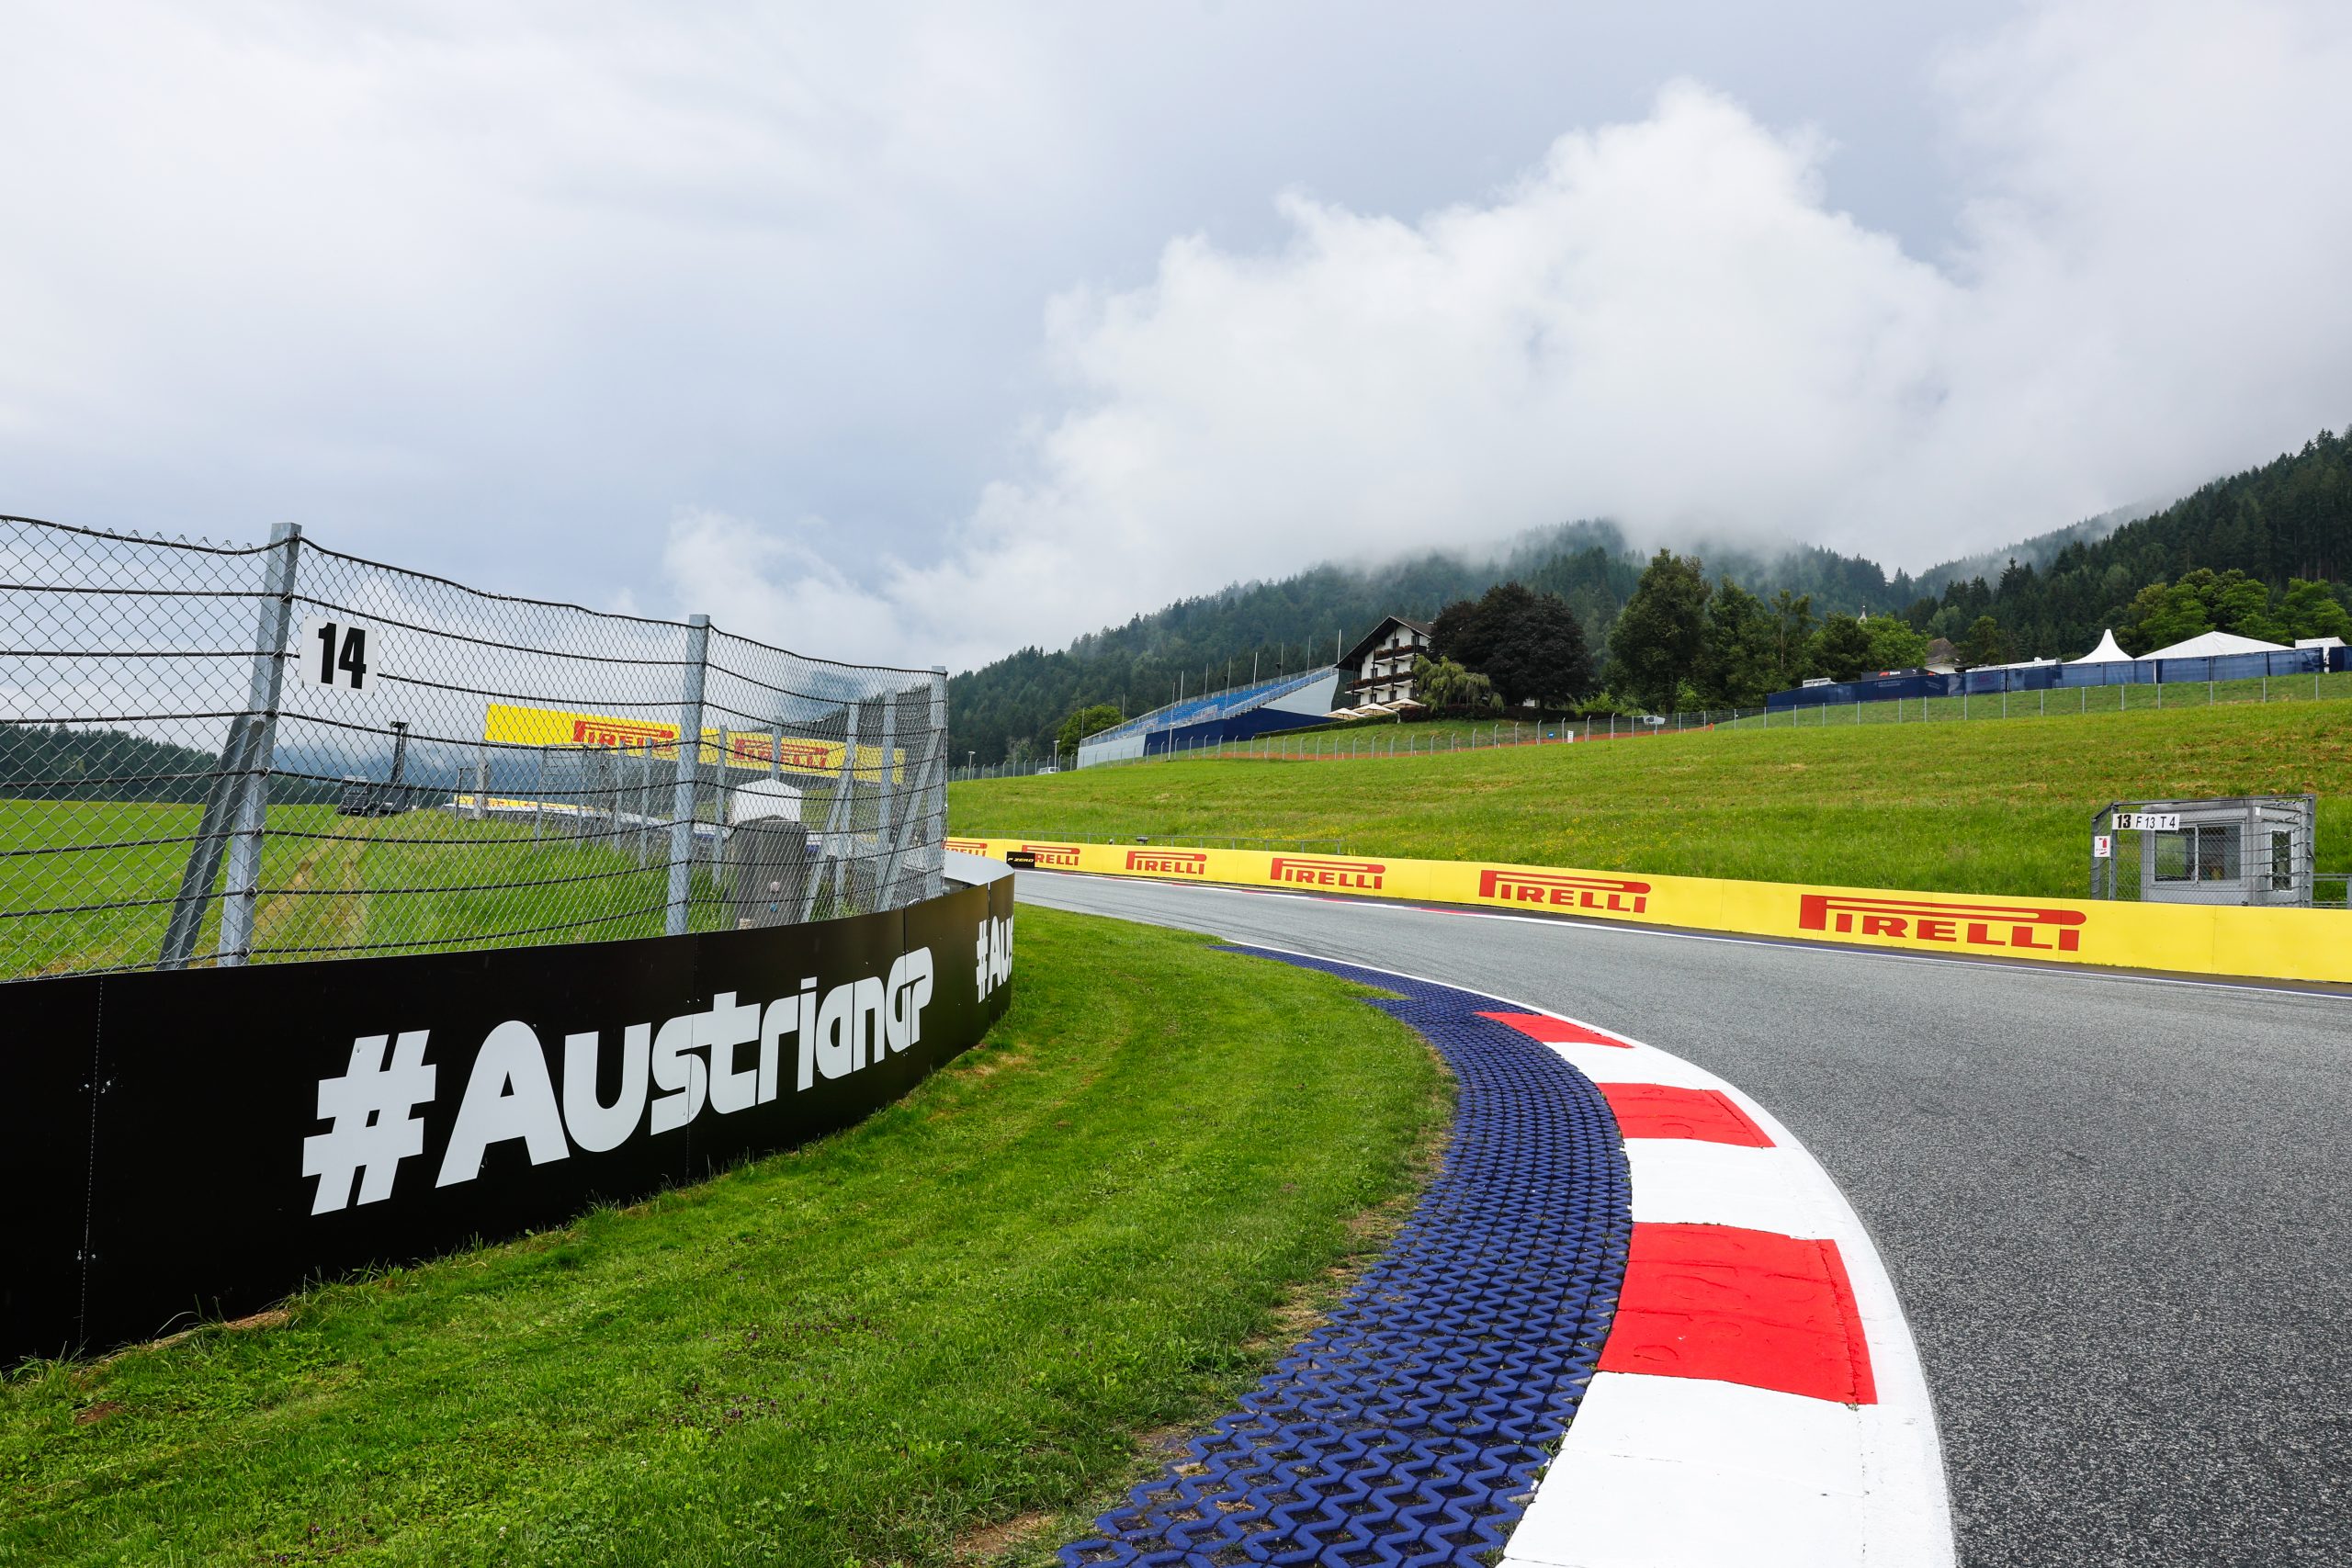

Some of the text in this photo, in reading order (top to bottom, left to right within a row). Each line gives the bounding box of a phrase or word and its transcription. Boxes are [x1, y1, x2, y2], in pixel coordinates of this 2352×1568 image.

[318, 622, 367, 690] 14
[2117, 814, 2176, 829] 13 F 13 T 4
[1022, 844, 1080, 866] PRELLI
[1125, 851, 1206, 874] PIRELLI
[1270, 857, 1385, 889] PIRELLI
[1479, 870, 1651, 914] PIRELLI
[1799, 894, 2086, 952] PIRELLI
